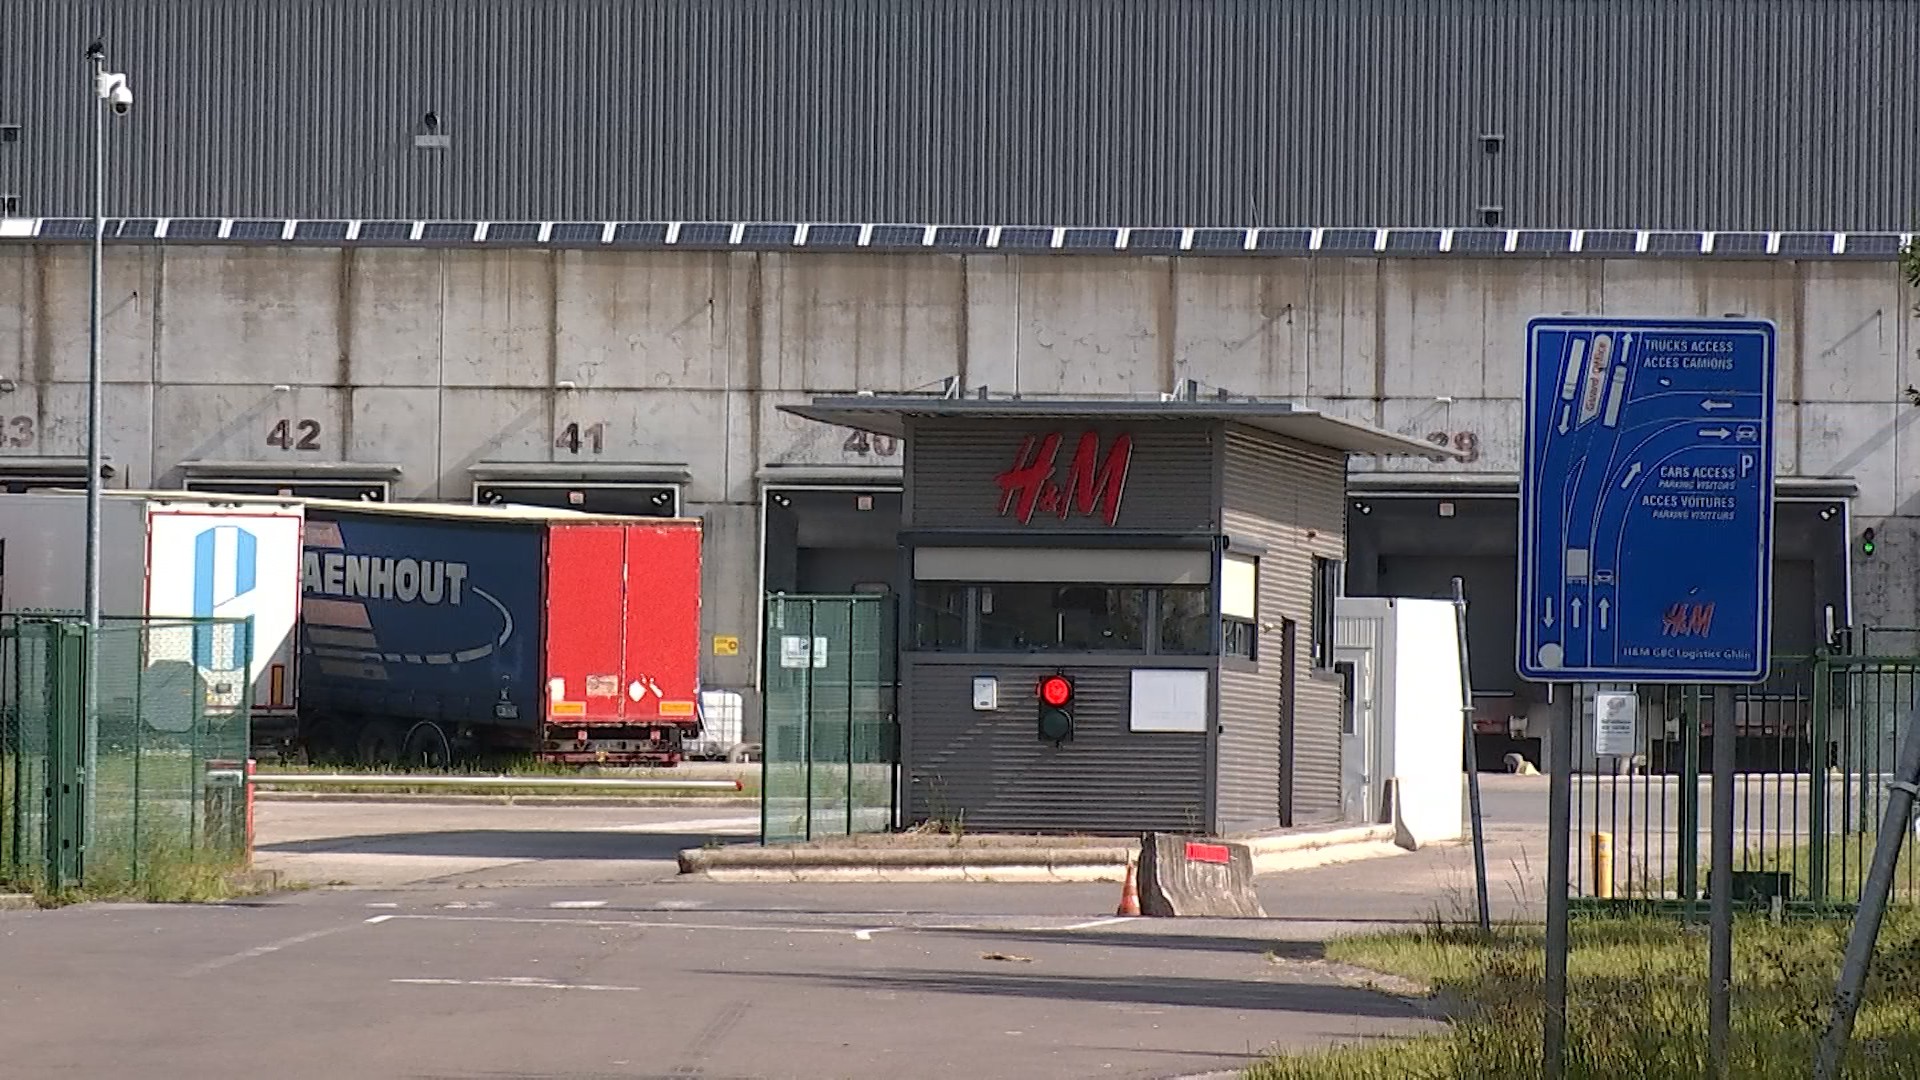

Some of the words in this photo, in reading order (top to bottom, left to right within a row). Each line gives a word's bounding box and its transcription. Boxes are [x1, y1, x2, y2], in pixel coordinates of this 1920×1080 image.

[1643, 339, 1688, 352] TRUCKS
[1690, 340, 1734, 353] ACCESS
[1643, 356, 1680, 369] ACCES
[1682, 357, 1734, 370] CAMIONS
[0, 416, 34, 448] 3
[266, 418, 322, 450] 42
[555, 422, 605, 454] 41
[1660, 466, 1690, 478] CARS
[1692, 466, 1737, 479] ACCESS
[1740, 454, 1754, 478] P
[992, 430, 1134, 527] H&M
[1657, 479, 1695, 489] PARKING
[1696, 480, 1737, 490] VISITORS
[1641, 495, 1678, 507] ACCES
[1680, 495, 1736, 508] VOITURES
[1652, 509, 1690, 519] PARKING
[1691, 510, 1736, 520] VISITEURS
[1662, 601, 1716, 638] H&M
[1676, 648, 1721, 661] Logistics
